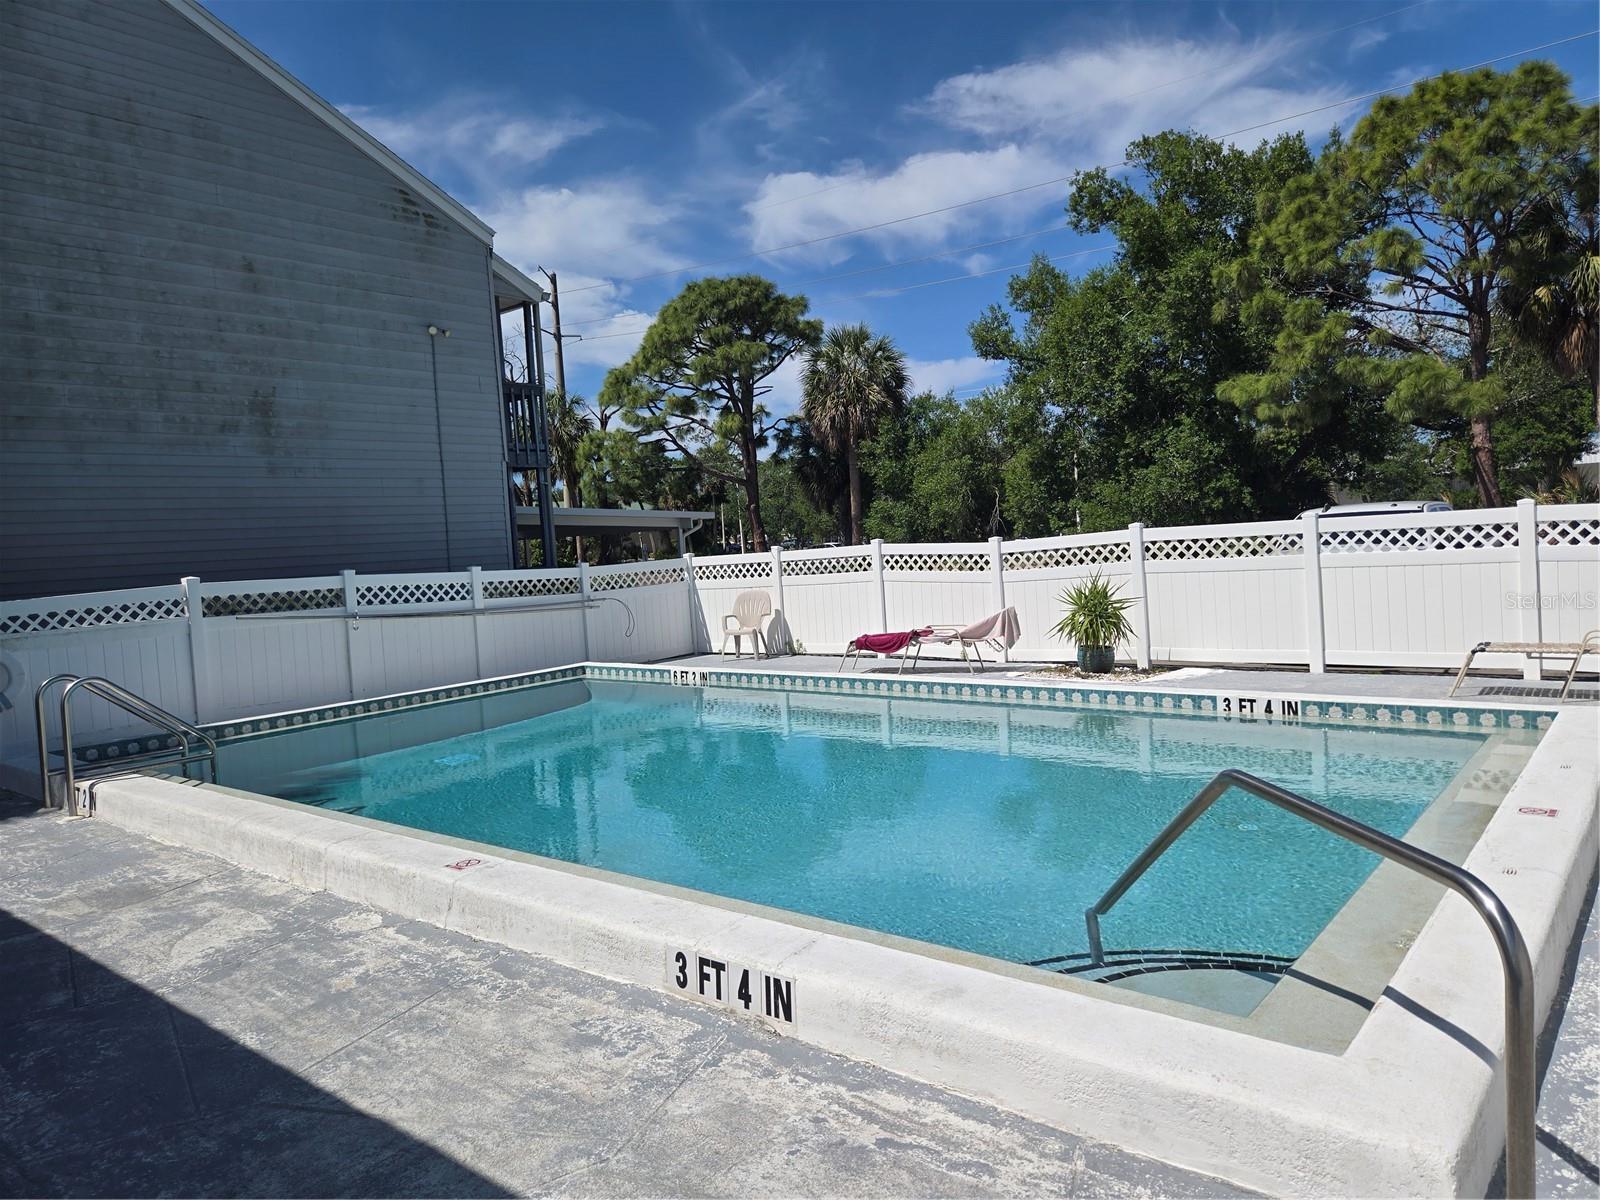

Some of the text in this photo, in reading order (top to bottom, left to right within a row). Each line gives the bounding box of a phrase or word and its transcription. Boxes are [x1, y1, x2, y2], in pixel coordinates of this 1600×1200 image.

[1223, 697, 1298, 716] 3 FT 4 IN
[675, 951, 793, 1023] 3 FT 4 IN
